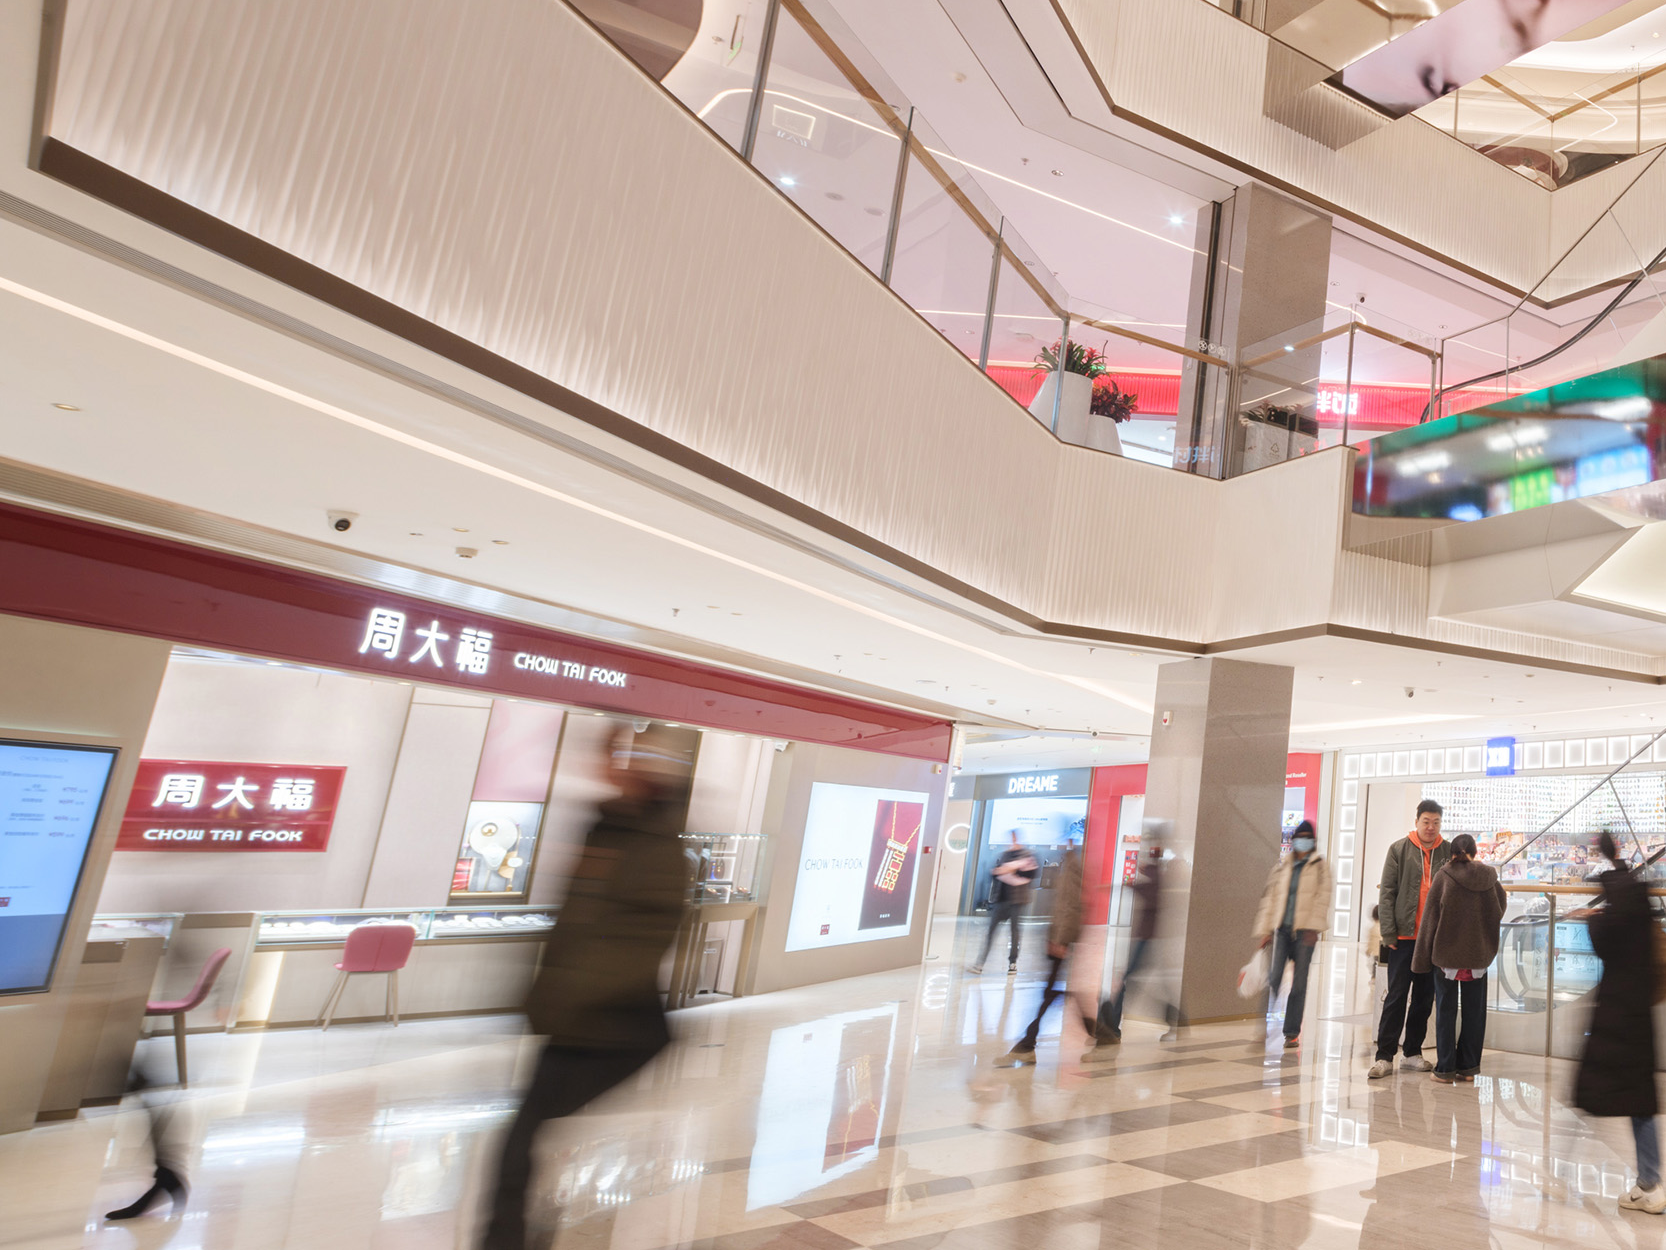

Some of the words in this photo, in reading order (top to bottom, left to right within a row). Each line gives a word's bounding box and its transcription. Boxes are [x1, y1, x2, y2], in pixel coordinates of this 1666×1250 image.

[358, 607, 494, 676] 周大福
[513, 651, 560, 676] CHOW
[561, 660, 585, 681] TAI
[587, 666, 627, 689] FOOK
[151, 773, 317, 811] 周大福
[1007, 774, 1059, 795] DREAME
[143, 828, 205, 842] CHOW
[209, 829, 243, 842] TAI
[247, 829, 304, 843] FOOK
[804, 858, 829, 871] CHOW
[831, 857, 843, 870] TAI
[844, 857, 865, 870] FOOK
